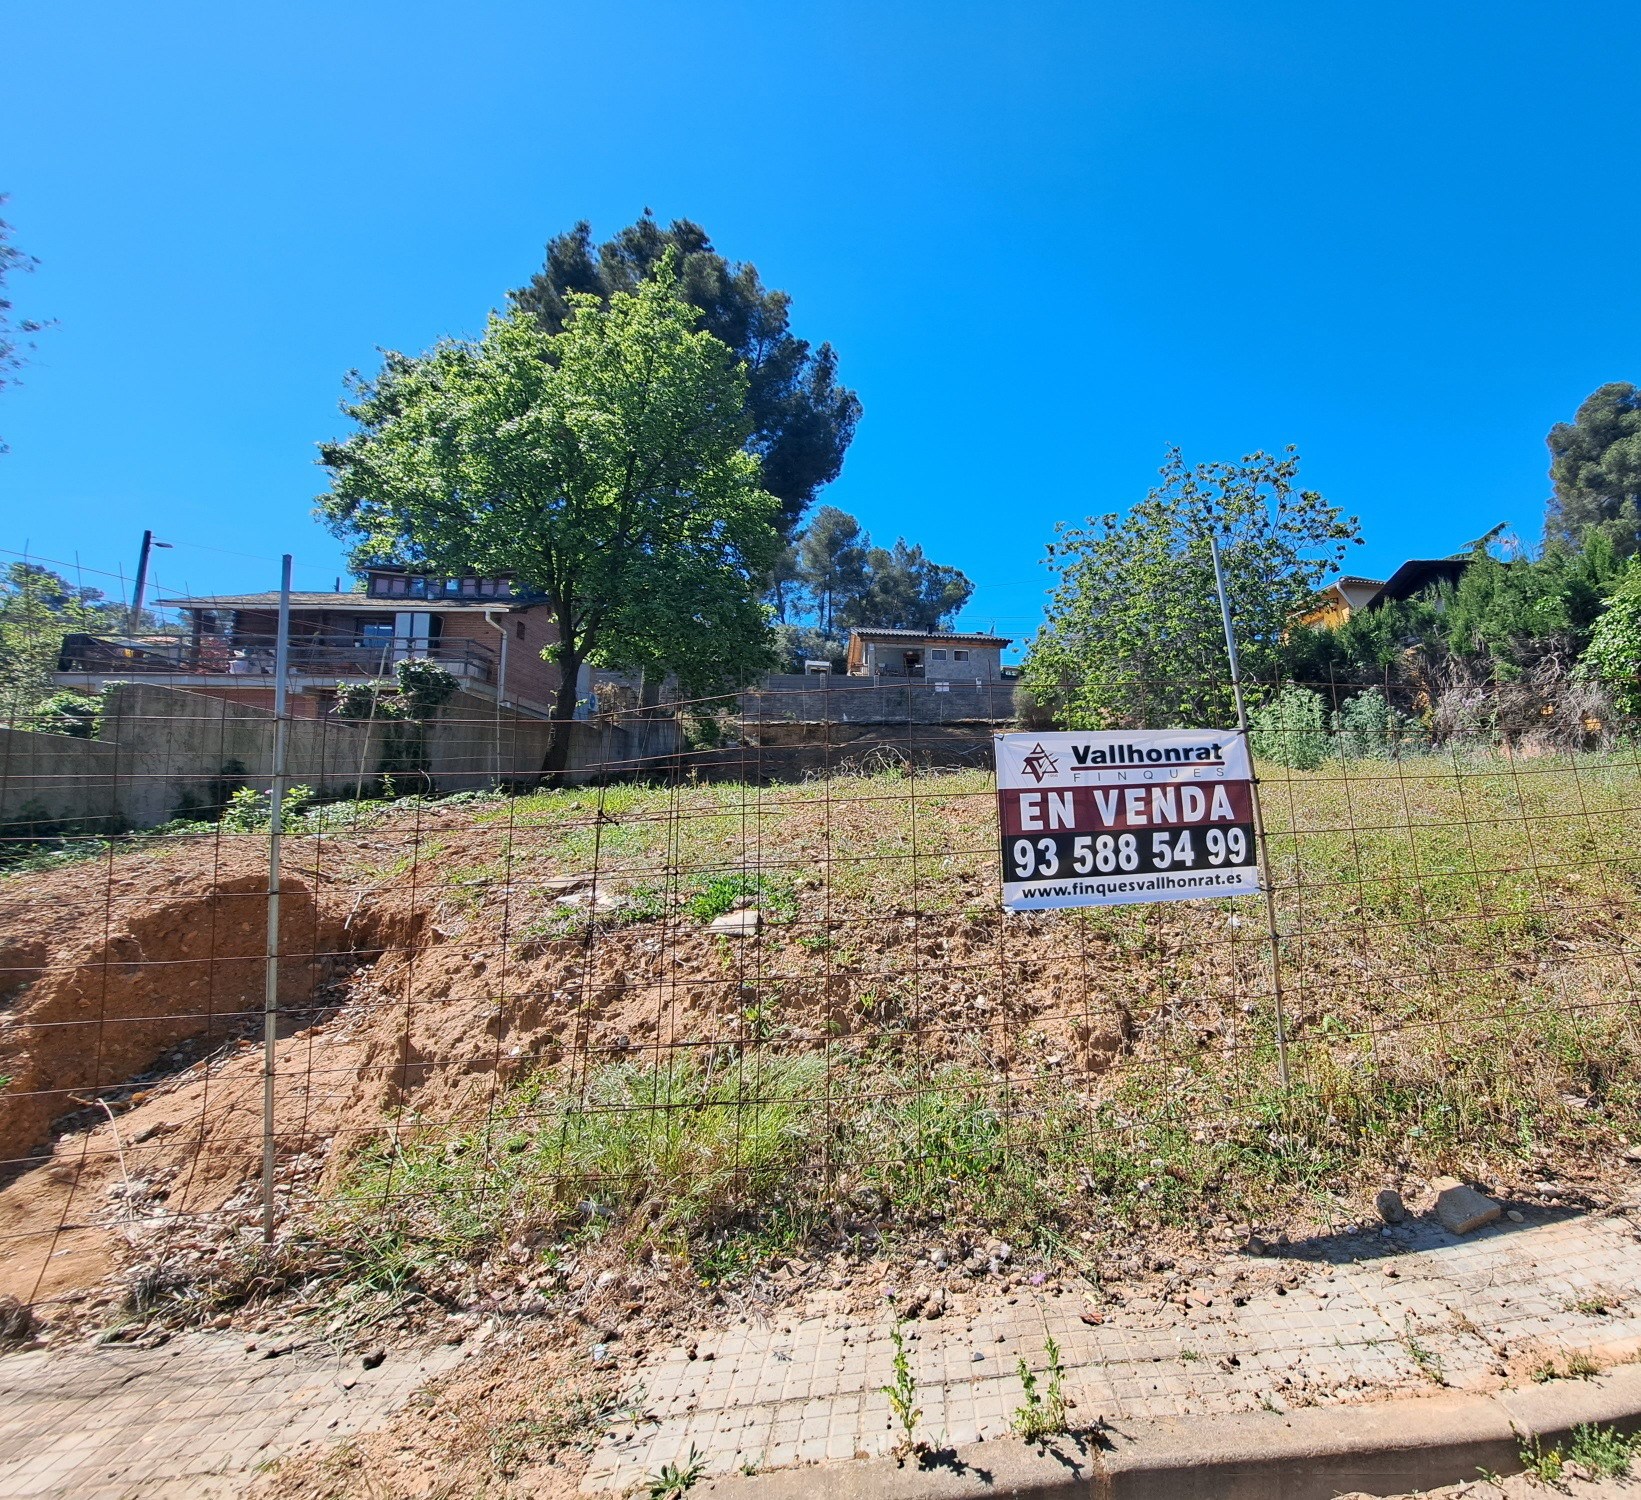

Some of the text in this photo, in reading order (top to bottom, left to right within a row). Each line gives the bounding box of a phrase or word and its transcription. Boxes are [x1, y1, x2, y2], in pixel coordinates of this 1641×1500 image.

[1071, 743, 1222, 765] Vallhonrat
[1073, 767, 1225, 782] FINQUES
[1019, 784, 1235, 831] EN VENDA
[1013, 827, 1246, 877] 93 588 54 99
[1022, 873, 1242, 899] www.finquesvallhonrat.es
